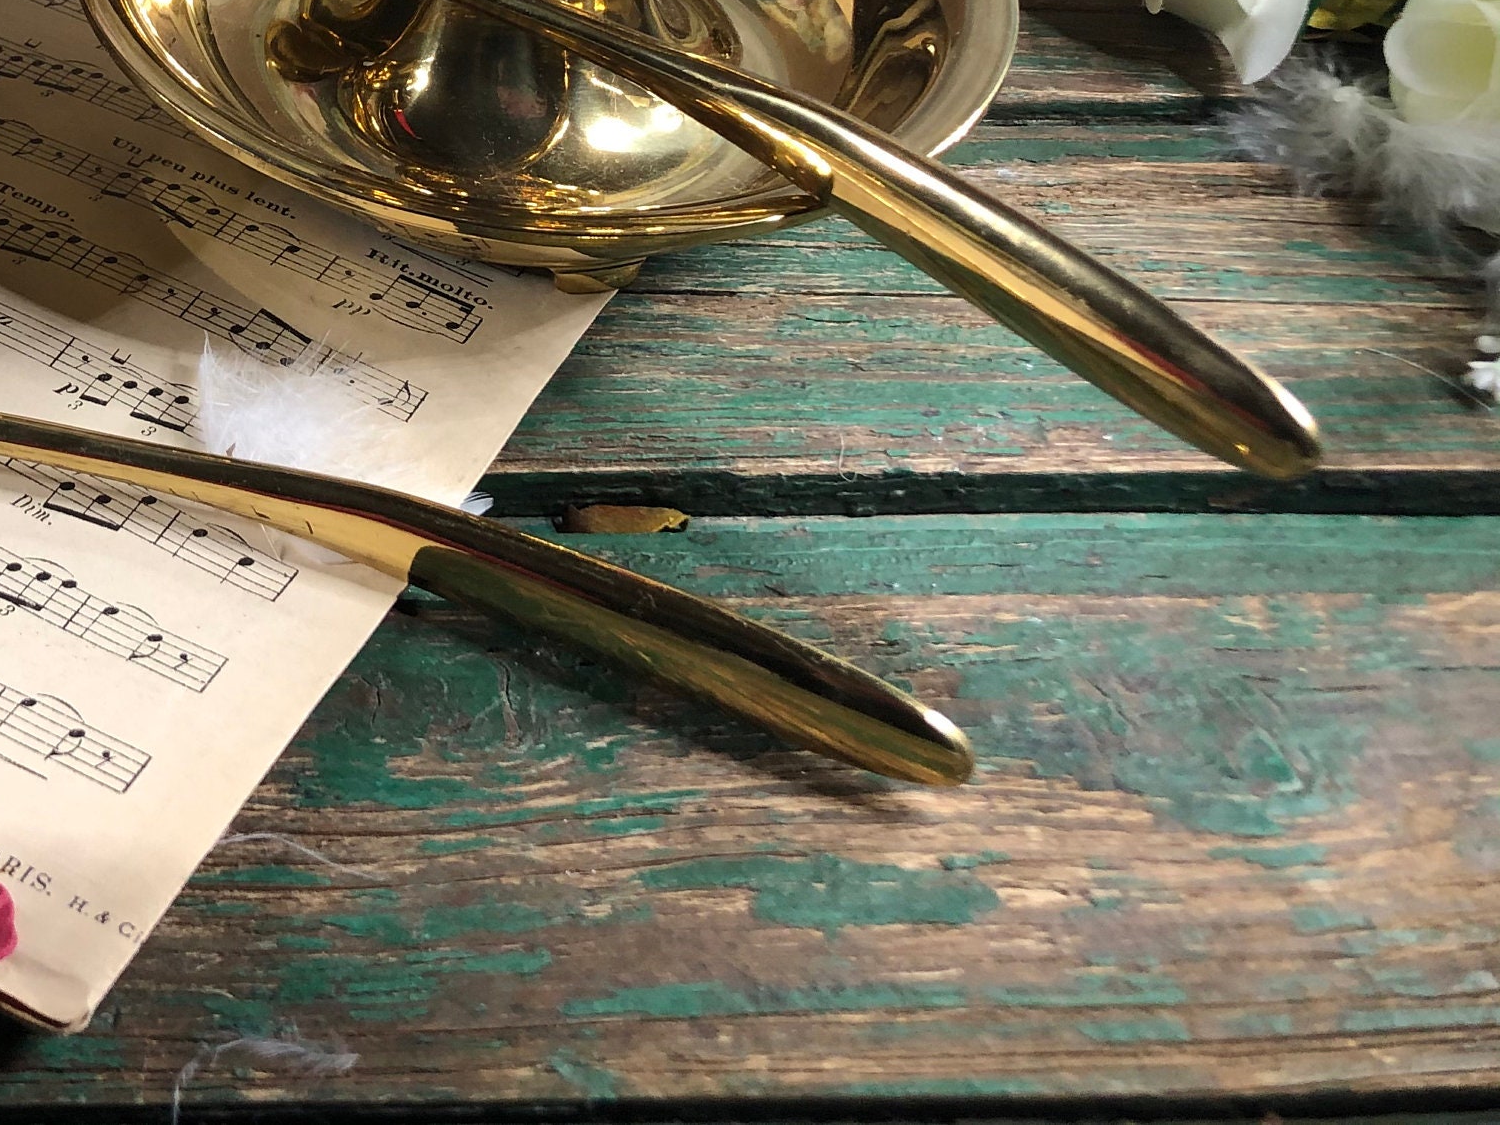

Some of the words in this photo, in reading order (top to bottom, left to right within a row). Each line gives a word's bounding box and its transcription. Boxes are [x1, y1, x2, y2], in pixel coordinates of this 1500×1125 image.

[112, 136, 142, 155] Un
[149, 153, 187, 173] peu
[190, 171, 241, 195] plus
[244, 191, 297, 220] lent.
[9, 493, 52, 525] Dim.
[94, 910, 110, 924] &
